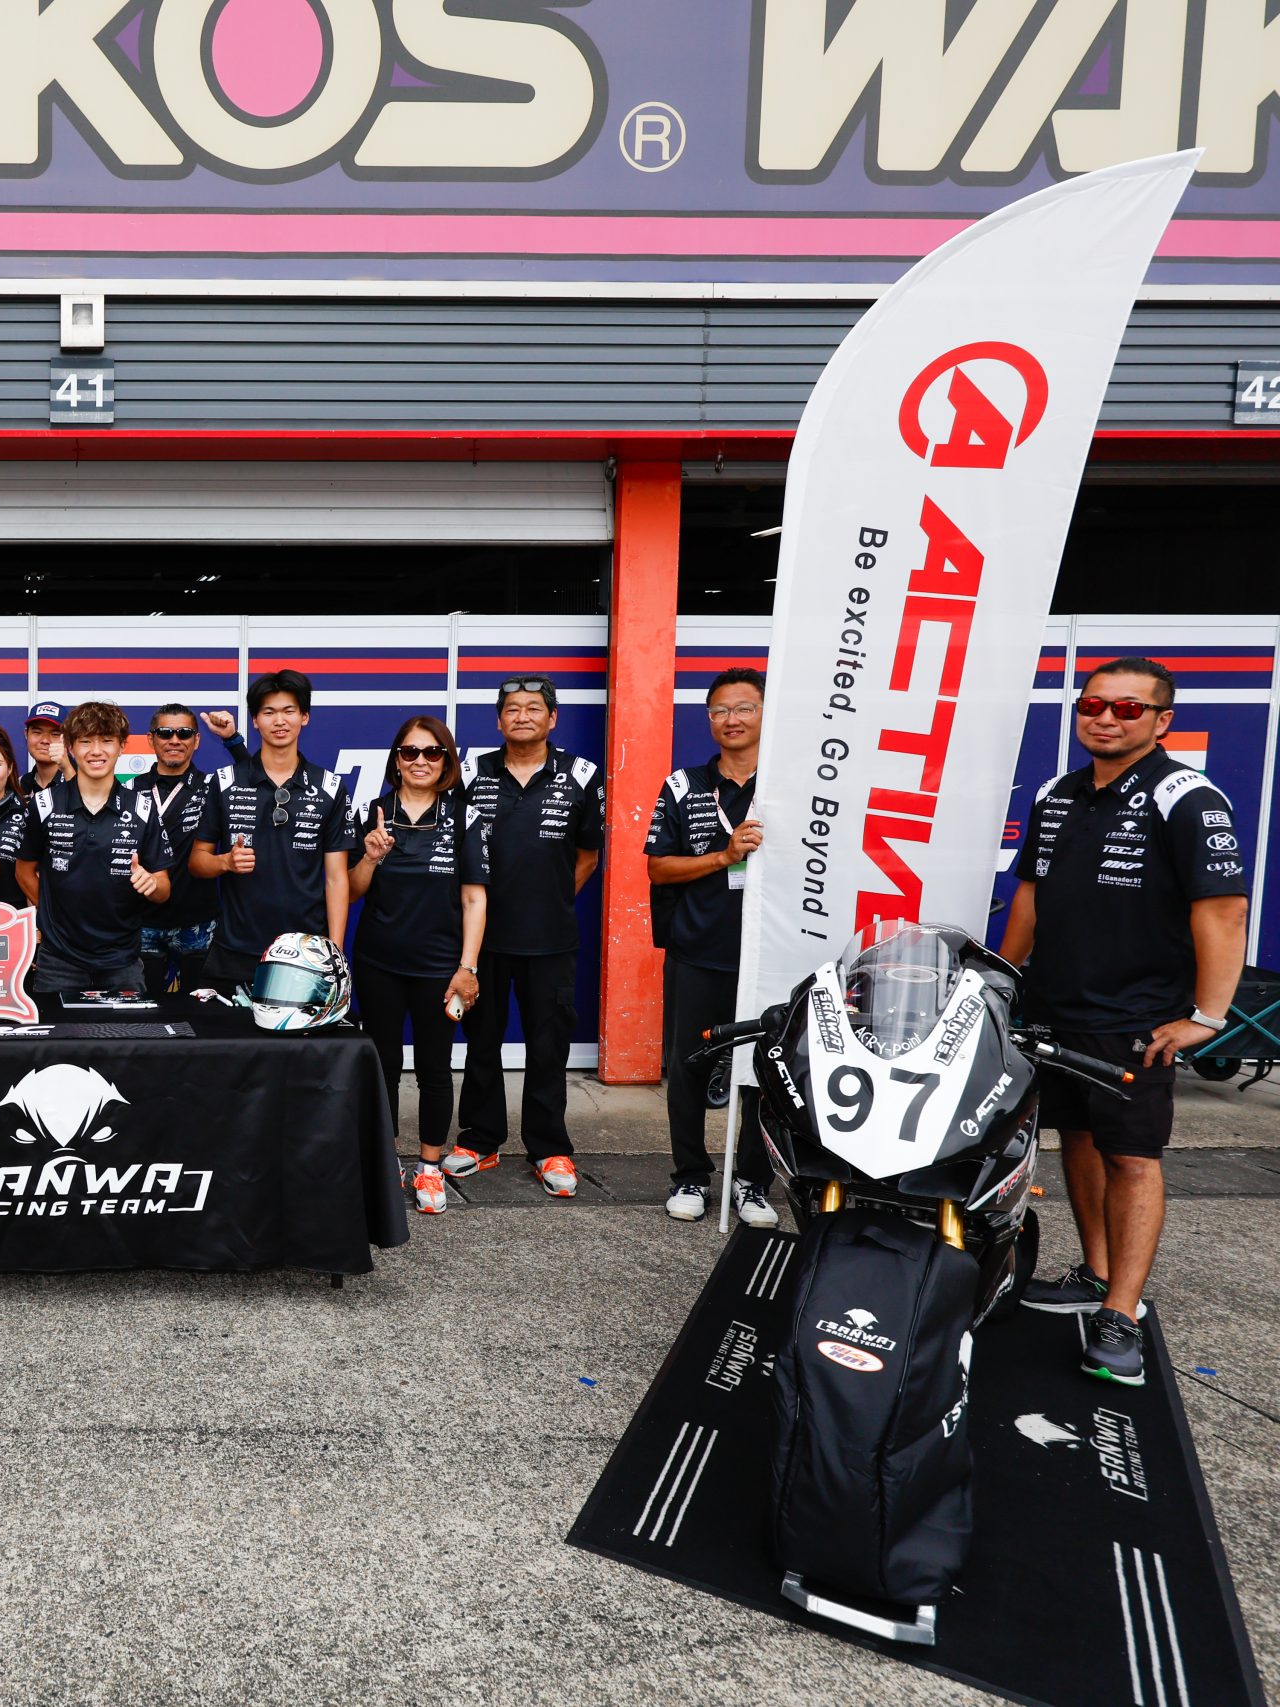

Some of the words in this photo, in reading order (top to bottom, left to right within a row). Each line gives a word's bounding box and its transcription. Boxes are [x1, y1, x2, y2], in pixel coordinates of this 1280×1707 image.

[55, 373, 106, 409] 41
[854, 526, 889, 570] Be
[822, 586, 871, 720] excited,
[855, 494, 984, 952] ACTIVE
[817, 737, 850, 782] Go
[540, 819, 568, 827] MKP
[801, 796, 840, 918] Beyond
[1100, 859, 1144, 870] MKP
[275, 945, 296, 956] Arai
[820, 993, 844, 1049] SANWA
[937, 999, 976, 1055] SANWA
[949, 1023, 971, 1058] RACING
[965, 1008, 981, 1030] TEAM
[774, 1060, 806, 1109] ACTIVE
[825, 1064, 941, 1143] 97
[975, 1072, 1014, 1122] ACTIVE
[80, 1197, 170, 1217] TEAM
[718, 1327, 737, 1355] RACING
[825, 1320, 890, 1346] SANWA
[825, 1328, 859, 1344] RACING
[707, 1354, 726, 1377] TEAM
[721, 1330, 759, 1387] SANWA
[1092, 1412, 1130, 1486] SANWA
[1122, 1423, 1140, 1449] TEAM
[1127, 1448, 1149, 1490] RACING
